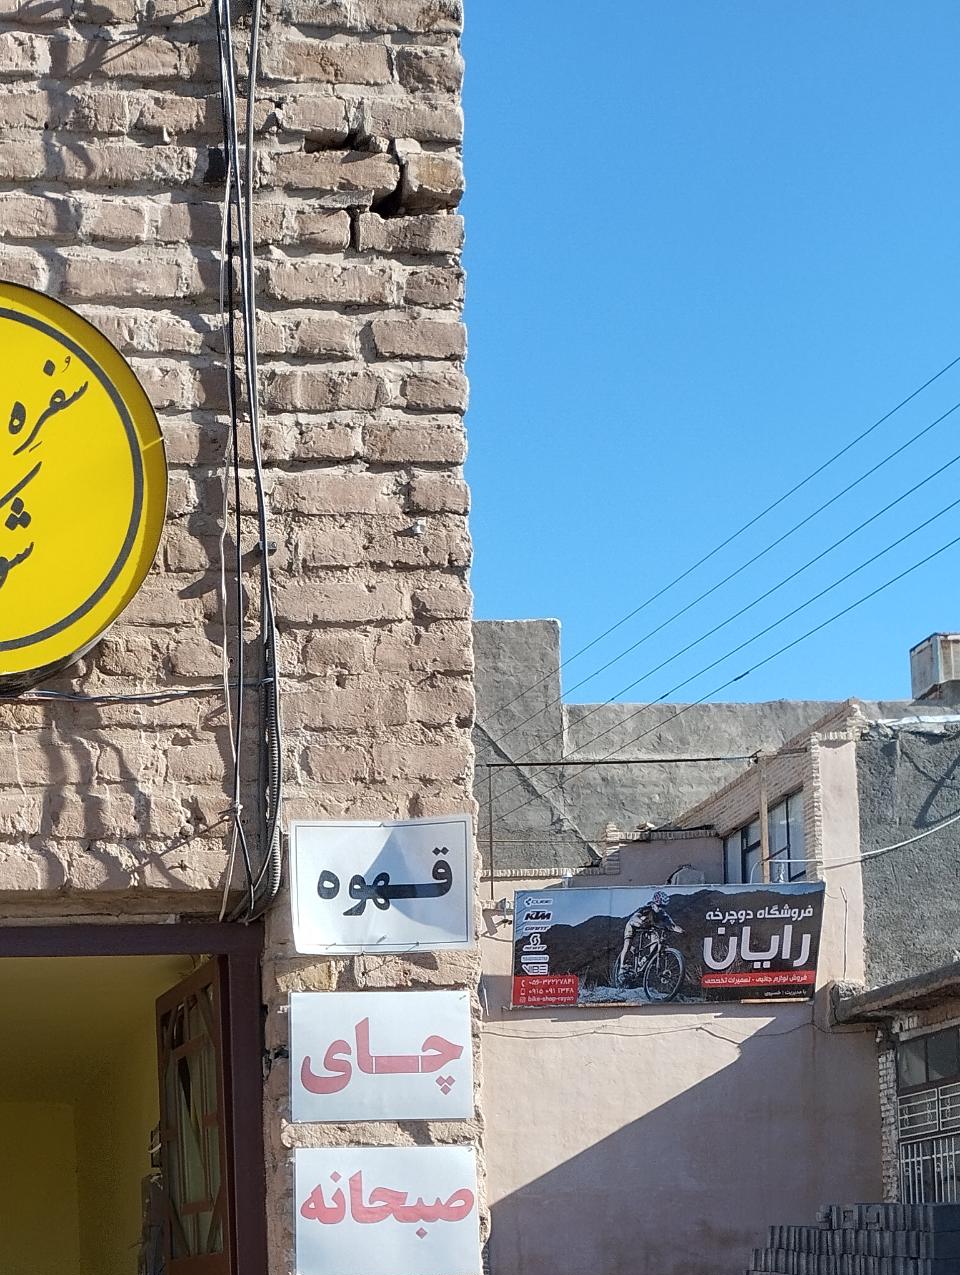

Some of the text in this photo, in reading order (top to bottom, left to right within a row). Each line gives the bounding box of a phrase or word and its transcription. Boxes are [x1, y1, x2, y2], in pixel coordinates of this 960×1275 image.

[317, 847, 453, 916] قهوه
[524, 911, 552, 920] KTM
[706, 904, 813, 924] فروشگاه دوچرخه
[703, 925, 811, 970] رایان
[790, 973, 808, 983] فروش
[300, 1017, 464, 1095] چای
[300, 1169, 473, 1239] صبحانه
